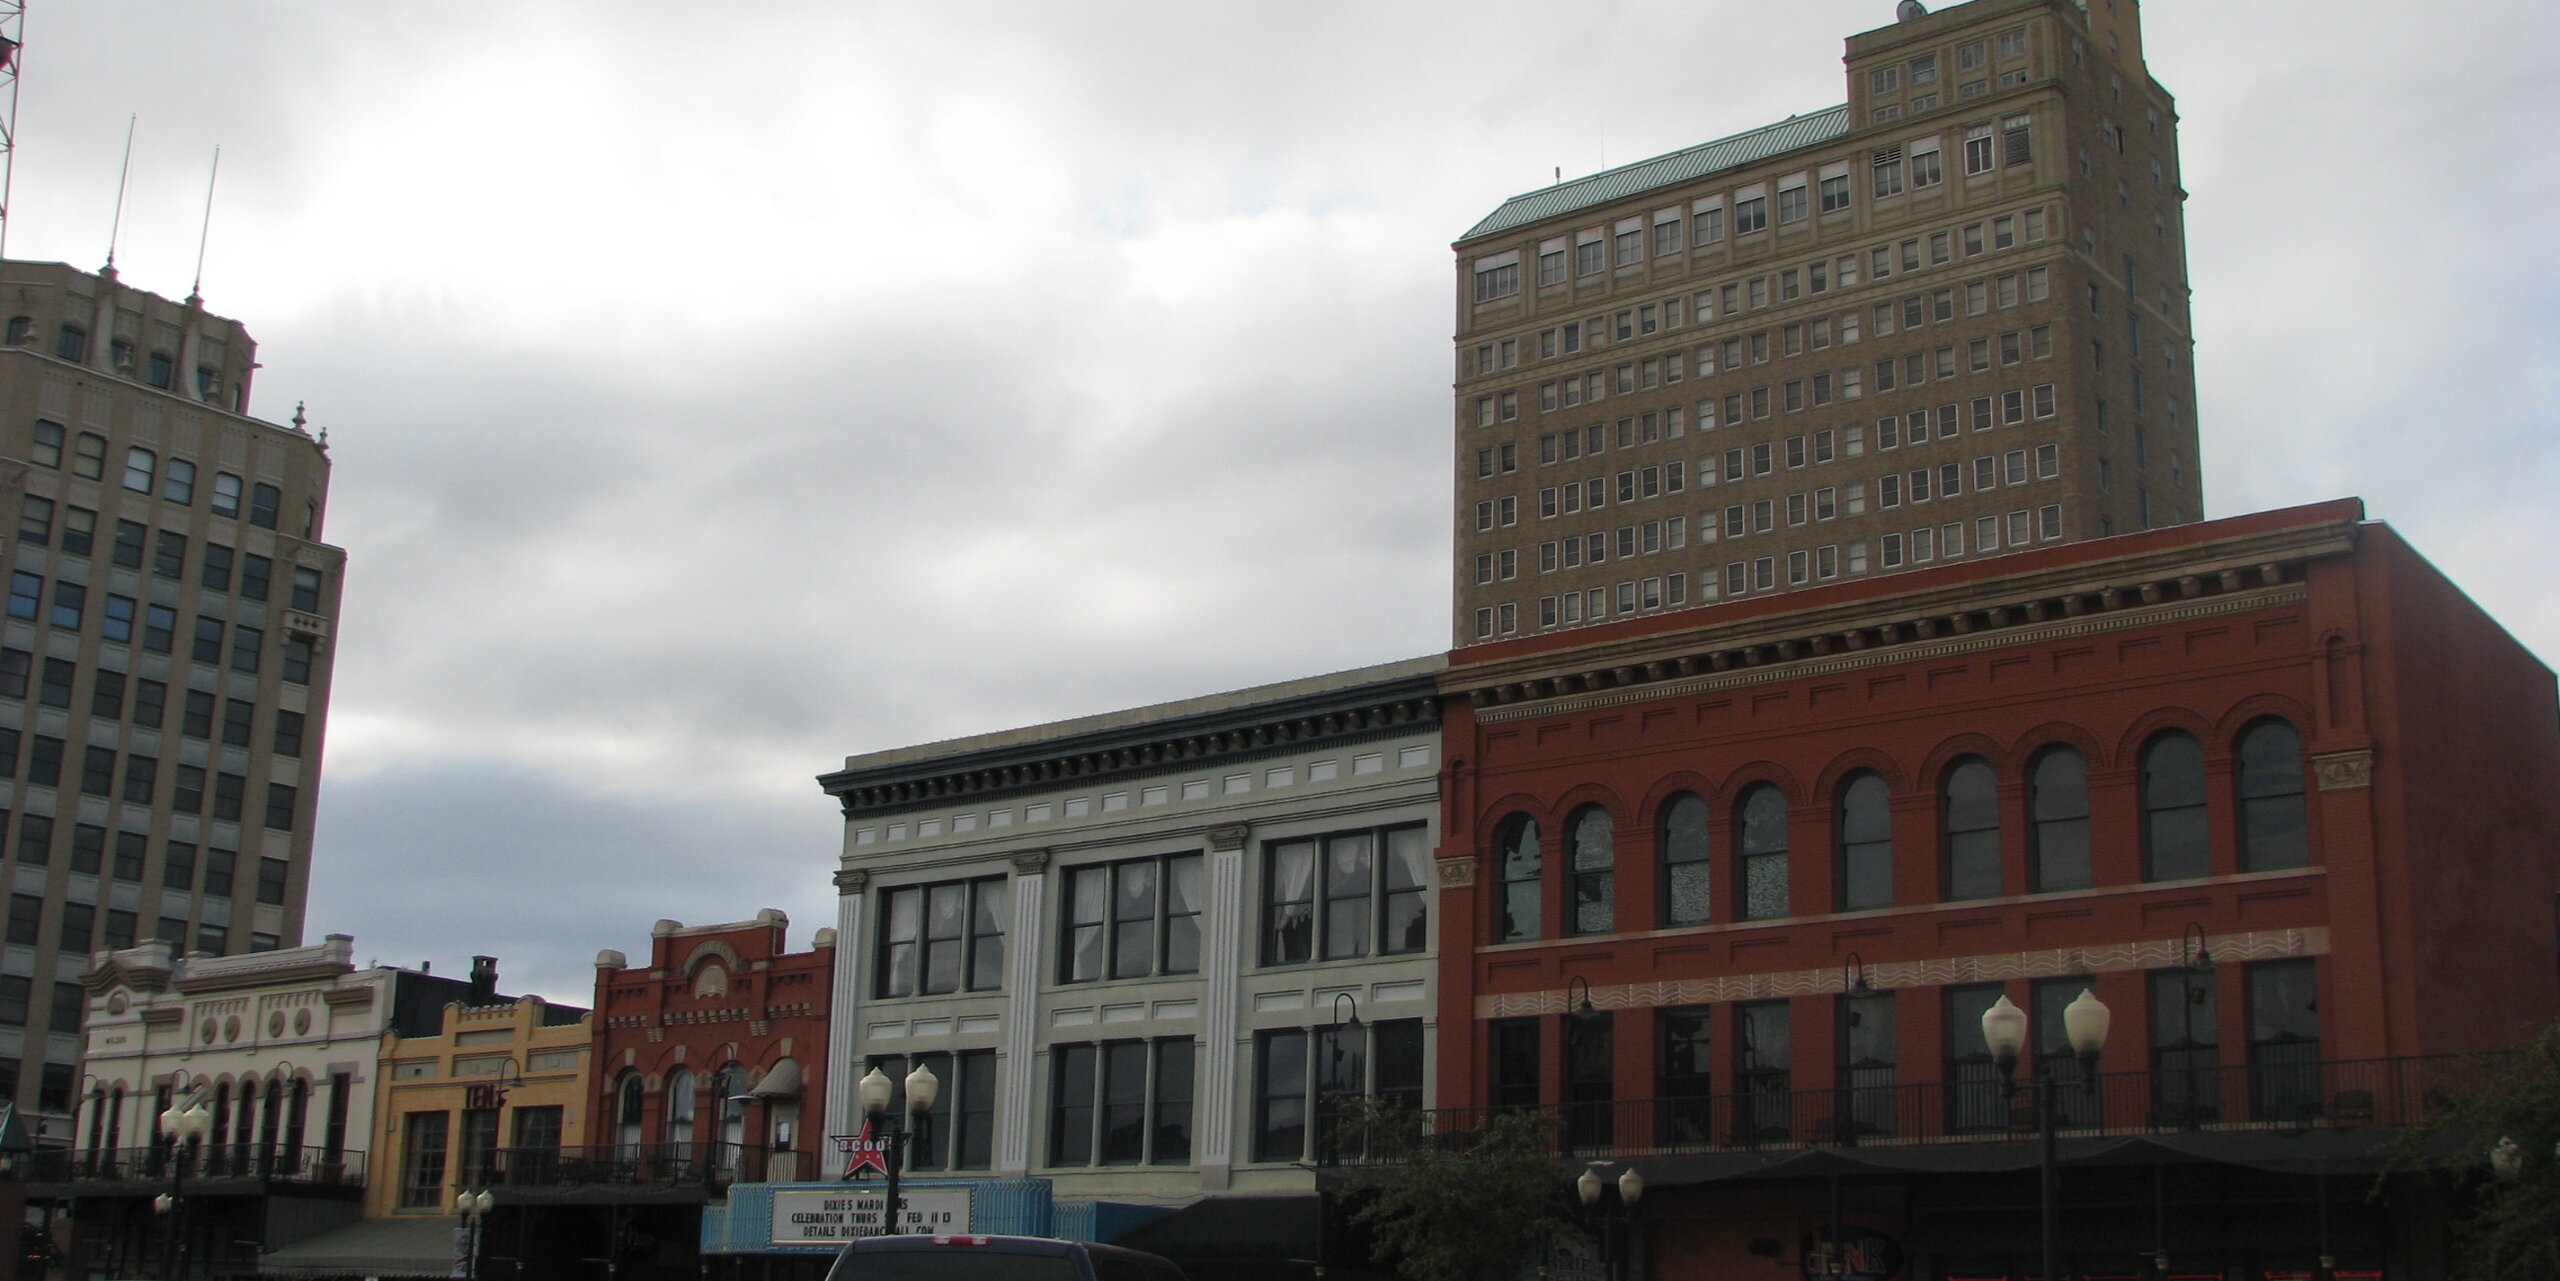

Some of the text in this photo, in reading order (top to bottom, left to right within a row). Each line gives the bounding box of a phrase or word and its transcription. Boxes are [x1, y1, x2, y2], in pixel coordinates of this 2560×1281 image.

[857, 1199, 884, 1211] MARDI
[791, 1212, 844, 1224] CELEBRATION
[851, 1212, 878, 1224] THURS
[803, 1225, 836, 1237] DETAILS
